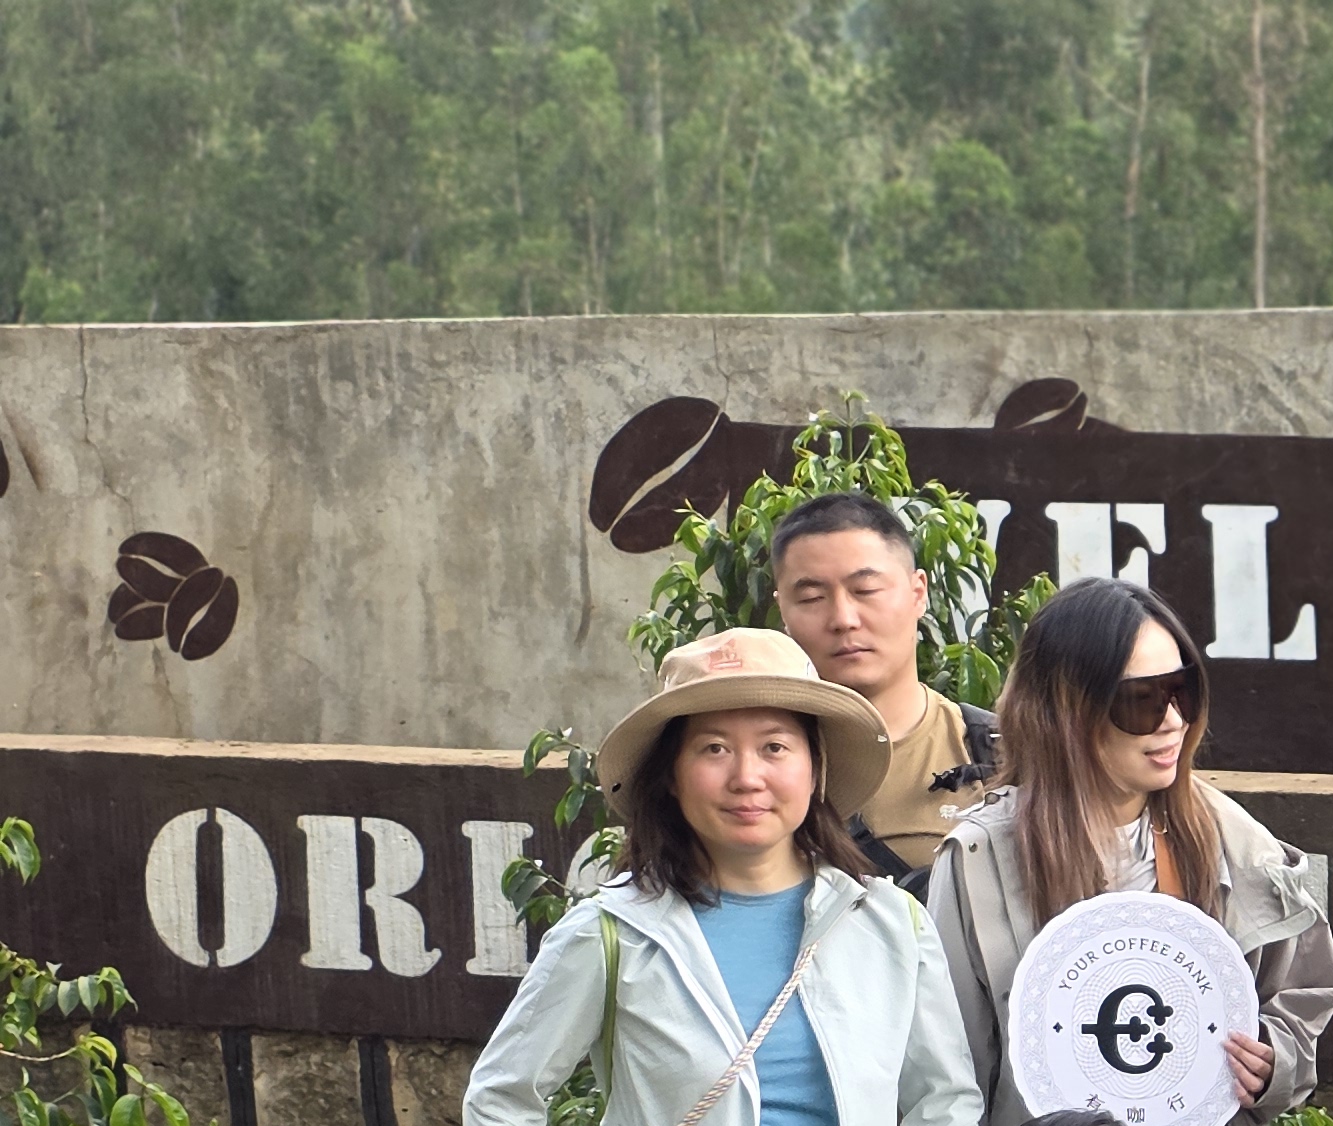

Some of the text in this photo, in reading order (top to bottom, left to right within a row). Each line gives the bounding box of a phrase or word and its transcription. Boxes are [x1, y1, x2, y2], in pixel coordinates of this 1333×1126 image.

[144, 807, 626, 978] ORI
[1058, 937, 1214, 996] YOUR COFFEE BANK
